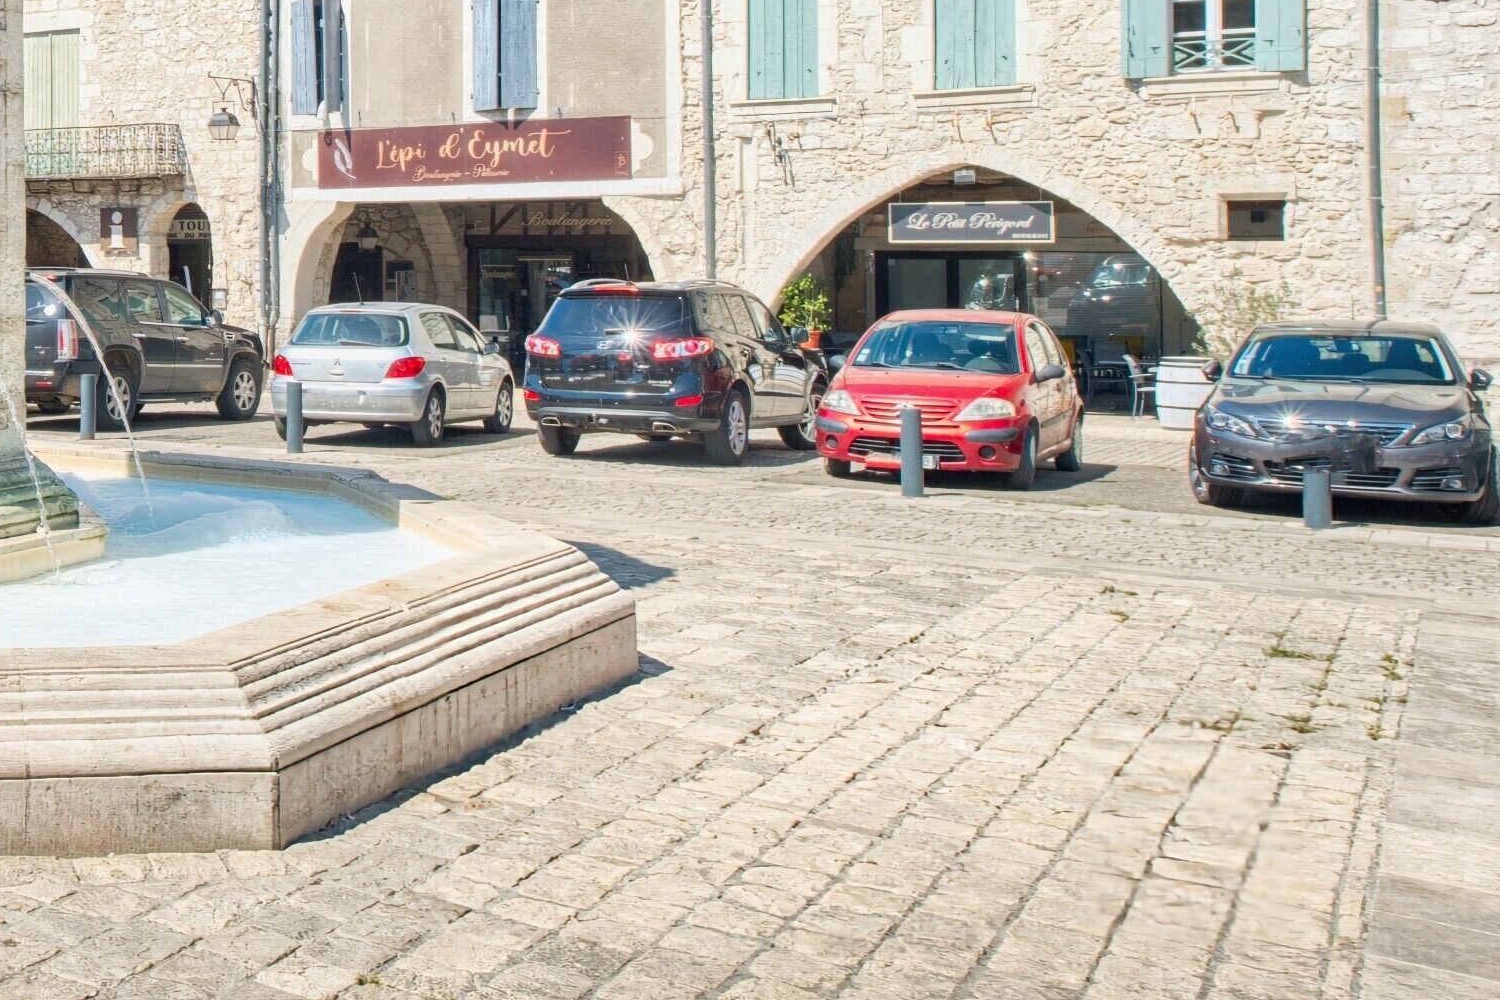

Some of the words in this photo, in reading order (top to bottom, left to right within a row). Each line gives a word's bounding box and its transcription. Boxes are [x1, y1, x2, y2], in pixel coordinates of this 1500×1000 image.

[179, 220, 210, 231] TOU
[522, 211, 612, 230] Boulangerie
[906, 212, 930, 230] Le
[932, 212, 968, 229] Petit
[969, 212, 1035, 235] Périgord
